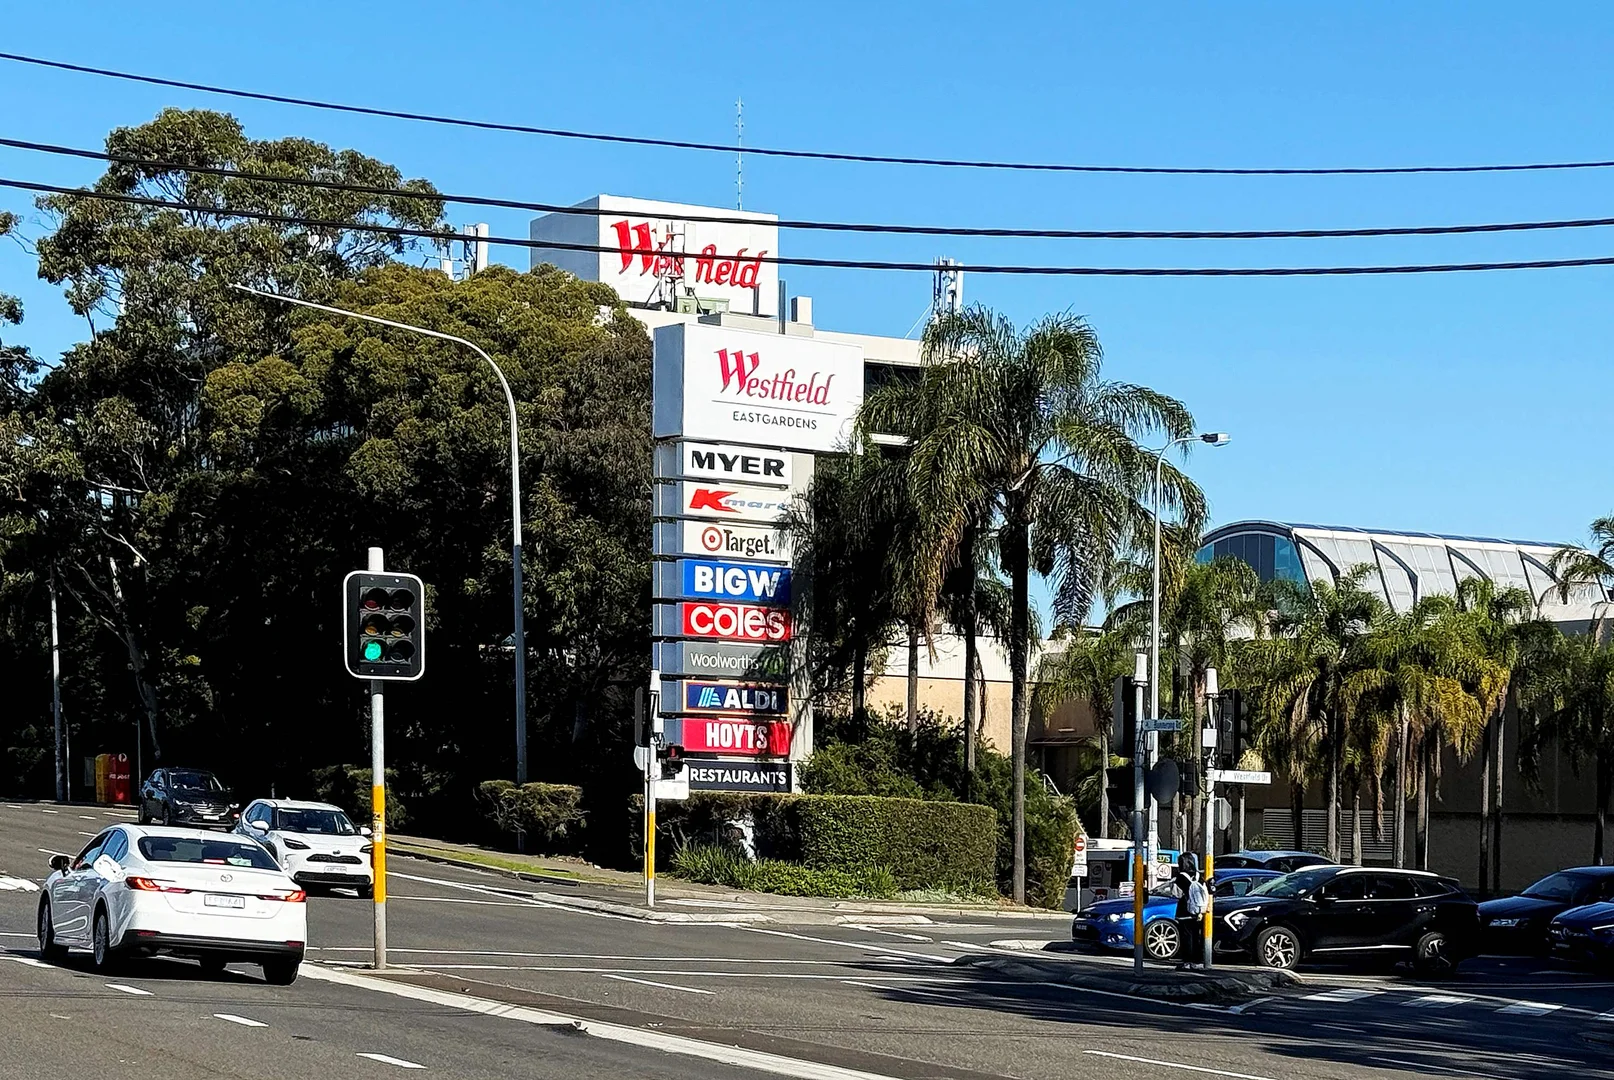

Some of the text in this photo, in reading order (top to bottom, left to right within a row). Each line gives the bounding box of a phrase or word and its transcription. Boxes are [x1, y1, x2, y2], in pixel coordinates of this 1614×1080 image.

[714, 348, 836, 406] Westfield
[732, 410, 818, 430] EASTGARDENS
[692, 450, 785, 478] MYER
[690, 605, 785, 639] coles
[690, 652, 759, 670] Woolworths
[723, 688, 778, 710] ALDI
[705, 722, 768, 749] HOYTS
[690, 768, 787, 785] RESTAURANTS
[1233, 772, 1261, 782] Westfield
